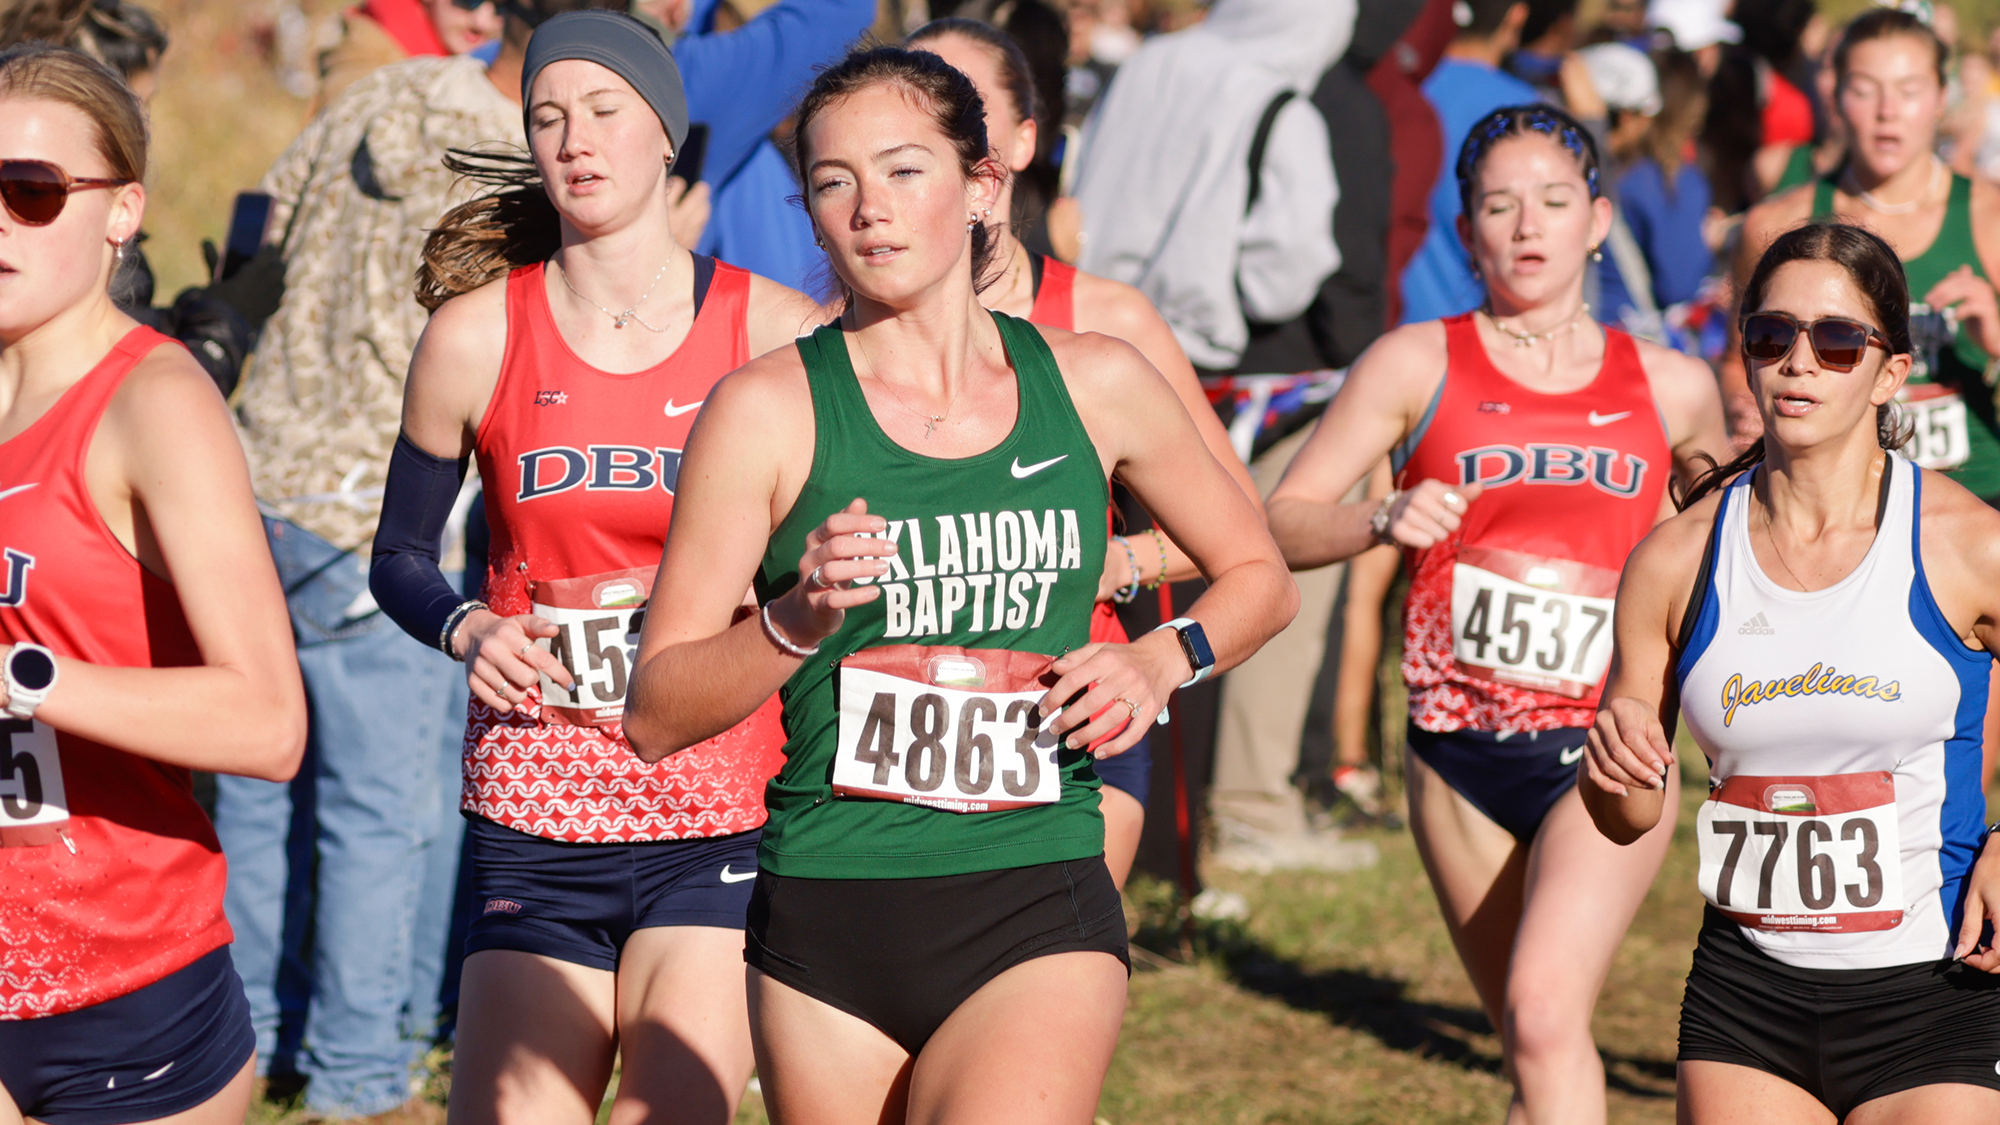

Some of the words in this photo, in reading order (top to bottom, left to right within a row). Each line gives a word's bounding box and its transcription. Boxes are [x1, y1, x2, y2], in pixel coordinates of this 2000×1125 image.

[1454, 443, 1649, 499] DBU
[853, 509, 1082, 585] KLAHOMA
[881, 571, 1059, 638] BAPTIST
[1462, 587, 1609, 676] 4537
[1738, 626, 1775, 636] adidas
[1721, 662, 1901, 728] Javelinas
[854, 692, 1041, 797] 4863
[903, 796, 989, 813] midwesttiming.com
[1711, 817, 1884, 911] 7763
[483, 899, 523, 915] DBU
[1760, 914, 1837, 927] midwesttiming.com
